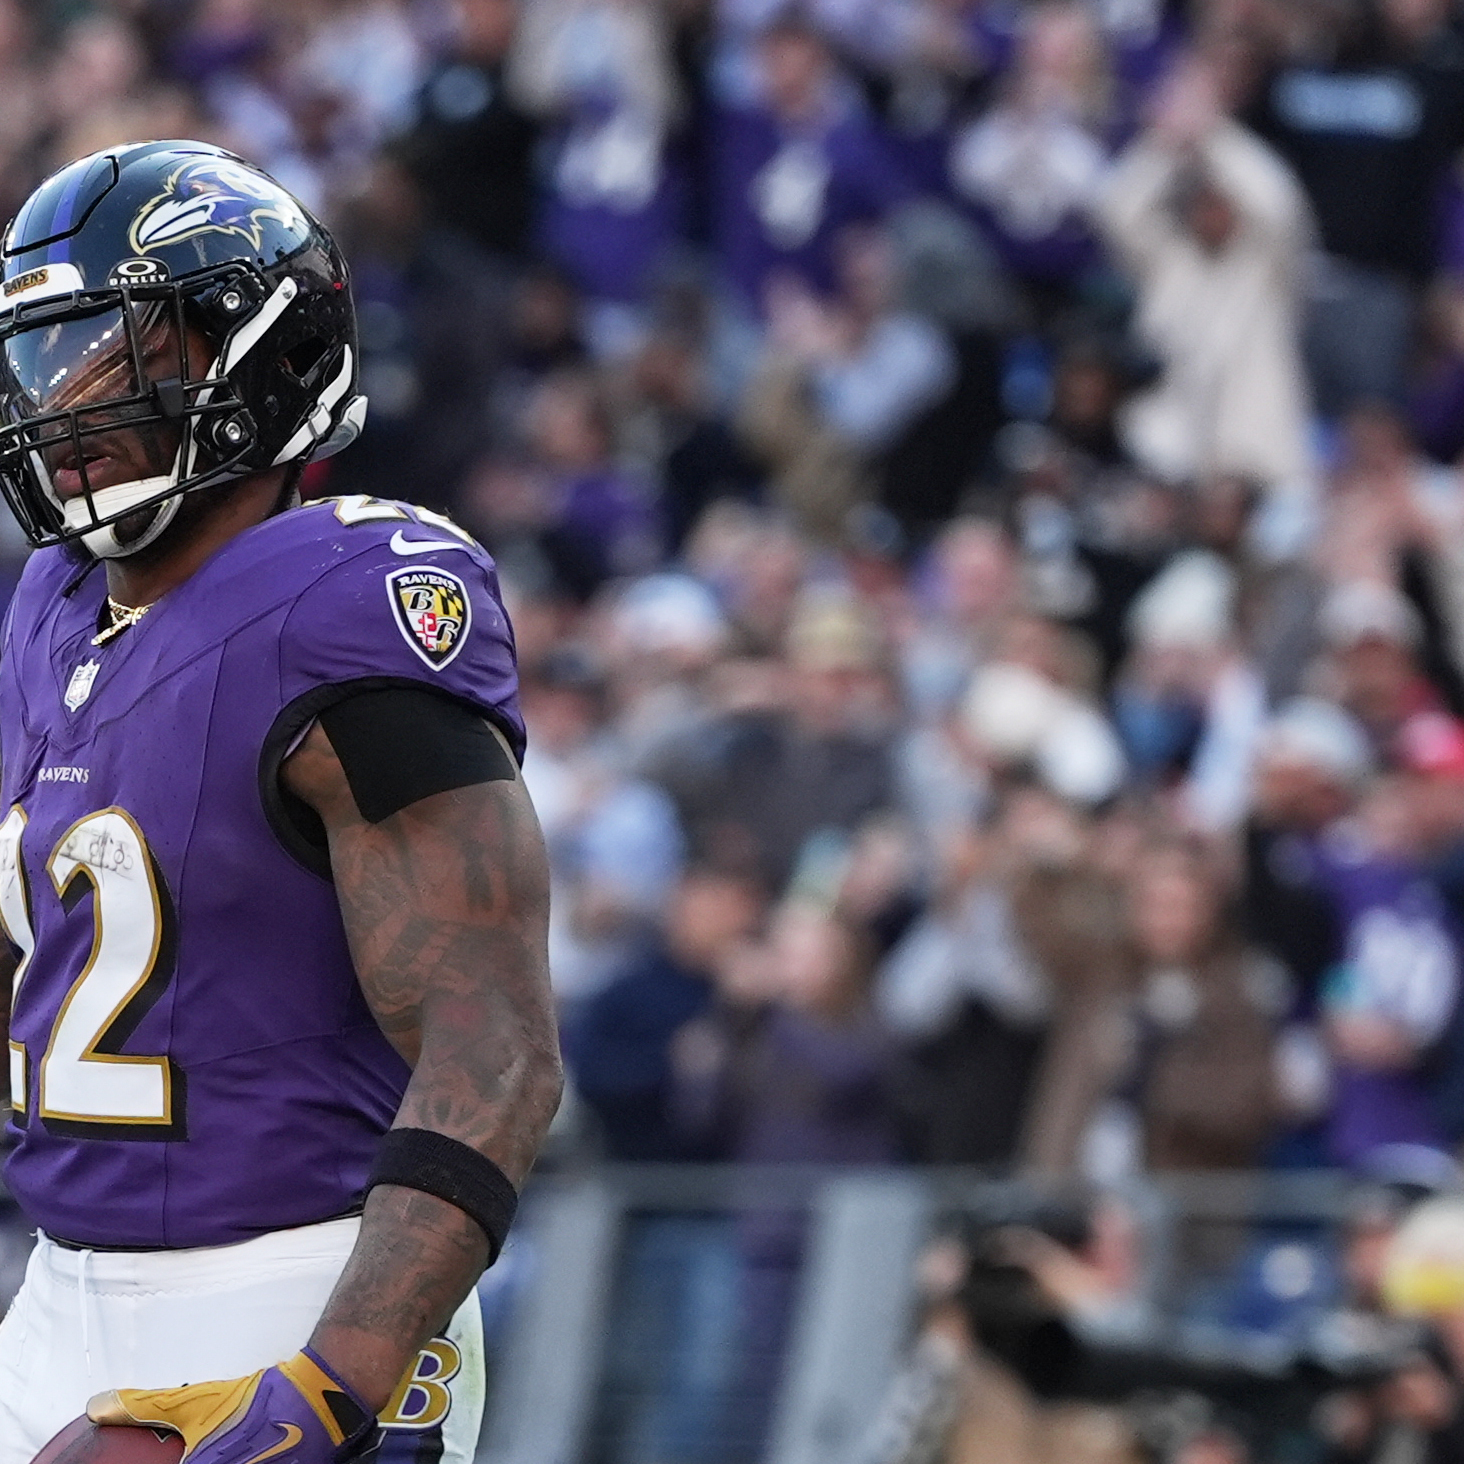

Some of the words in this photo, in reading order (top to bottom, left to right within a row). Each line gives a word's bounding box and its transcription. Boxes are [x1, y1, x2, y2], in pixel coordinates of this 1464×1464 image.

[3, 268, 50, 297] RAVENS
[108, 273, 168, 286] OAKLEY
[397, 573, 458, 591] RAVENS
[37, 766, 90, 784] RAVENS
[376, 1337, 462, 1429] B
